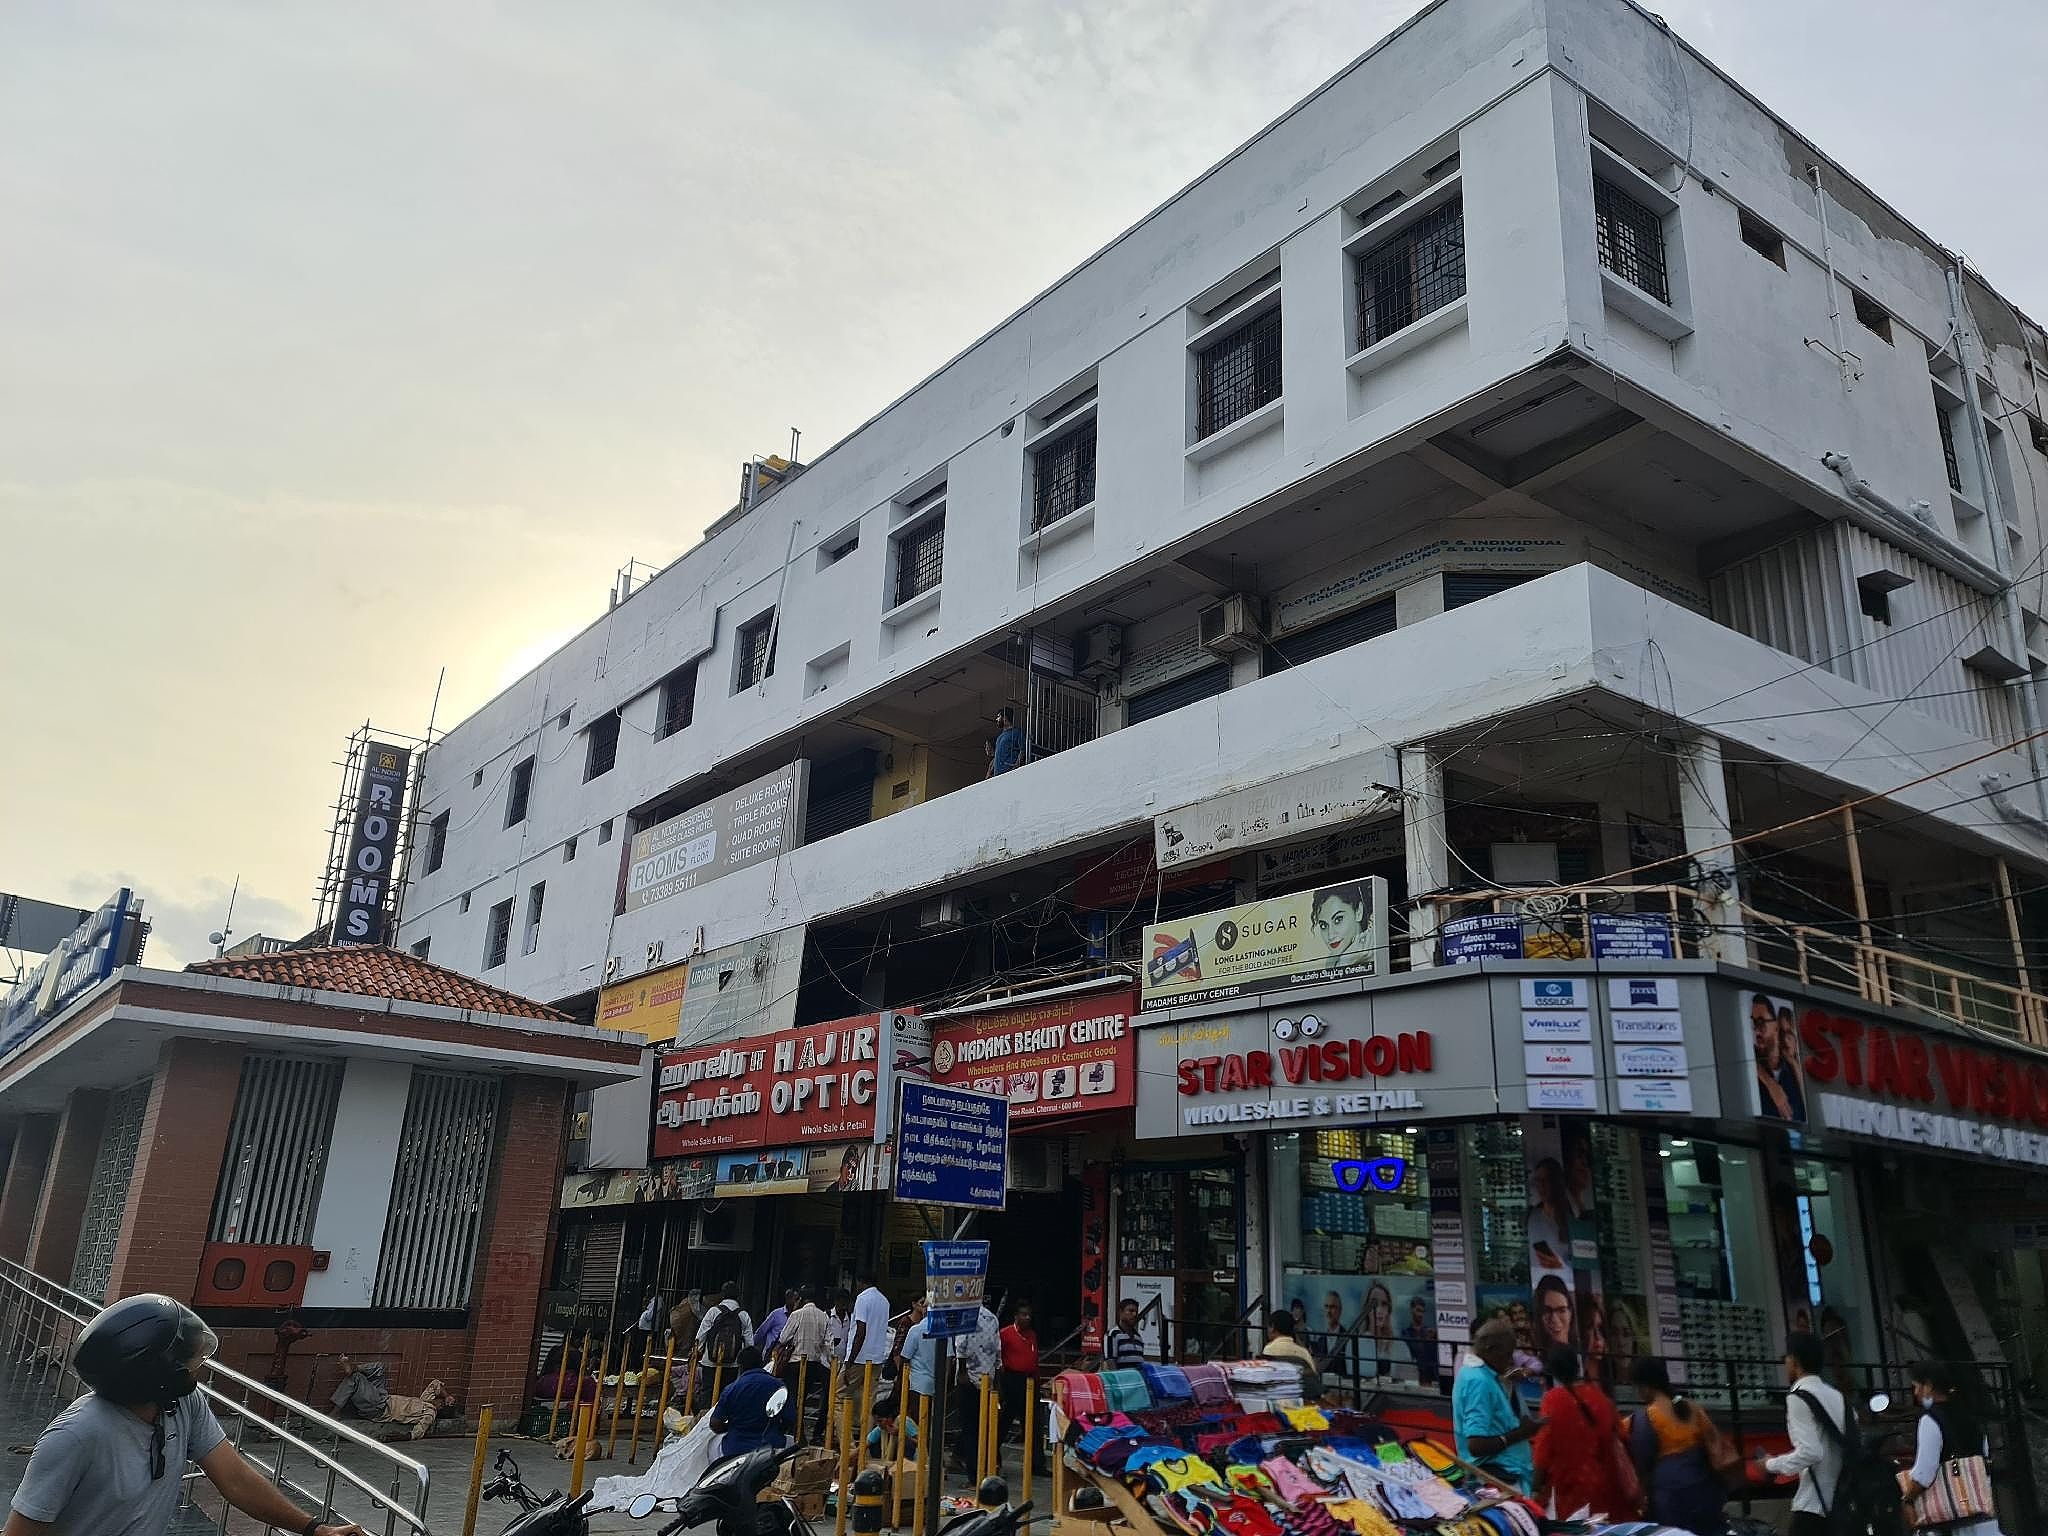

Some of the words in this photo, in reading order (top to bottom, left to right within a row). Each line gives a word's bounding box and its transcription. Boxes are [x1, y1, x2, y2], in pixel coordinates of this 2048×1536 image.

[1396, 539, 1450, 563] HOUSES
[1308, 583, 1356, 606] HOUSES
[1359, 573, 1380, 586] ARE
[1382, 548, 1441, 574] SELLING
[735, 789, 764, 811] DELUXE
[764, 776, 793, 798] ROOMS
[679, 806, 714, 830] RESIDENCY
[733, 808, 759, 829] TRIPLE
[759, 797, 788, 816] ROOMS
[650, 834, 677, 854] BUSINESS
[677, 826, 695, 843] CLASS
[695, 818, 713, 835] HOTEL
[731, 829, 752, 847] QUAD
[752, 816, 782, 838] ROOMS
[346, 783, 394, 937] ROOMS
[730, 847, 751, 864] SUITE
[752, 835, 781, 855] ROOMS
[634, 846, 688, 889] ROOMS
[1241, 915, 1299, 939] SUGAR
[1460, 932, 1497, 944] Advocate
[1214, 954, 1234, 966] LONG
[1235, 949, 1266, 963] LASTING
[1266, 943, 1298, 958] MAKEUP
[1218, 965, 1230, 974] FOR
[1231, 963, 1243, 973] THE
[1244, 961, 1262, 970] BOLD
[1262, 958, 1276, 968] AND
[1277, 955, 1293, 966] FREE
[1146, 996, 1178, 1010] MADAMS
[1178, 991, 1208, 1004] BEAUTY
[1208, 986, 1240, 998] CENTER
[957, 1033, 1012, 1064] MADAMS
[1013, 1024, 1069, 1054] BEAUTY
[1069, 1013, 1125, 1044] CENTRE
[1616, 1020, 1678, 1032] Transitions
[1006, 1058, 1020, 1070] And
[1052, 1054, 1062, 1063] Of
[1061, 1048, 1093, 1063] Cosmetic
[1094, 1045, 1118, 1057] Goods
[1177, 1050, 1273, 1096] STAR
[1278, 1030, 1433, 1085] VISION
[1545, 1055, 1573, 1064] Kodak
[1801, 1007, 1937, 1105] STAR
[656, 1082, 762, 1129] ஆப்டிக்ஸ்
[1540, 1088, 1584, 1100] ACUVUE
[1183, 1099, 1311, 1126] WHOLESALE
[1312, 1095, 1332, 1116] &
[1335, 1090, 1424, 1114] RETAIL
[801, 1123, 823, 1135] Whole
[823, 1122, 838, 1134] Sale
[1818, 1091, 1983, 1154] WHOLESALE
[1982, 1123, 2004, 1156] &
[682, 1137, 699, 1147] Whole
[699, 1136, 712, 1146] Sale
[717, 1134, 734, 1144] Retail
[1438, 1311, 1469, 1326] Alcon
